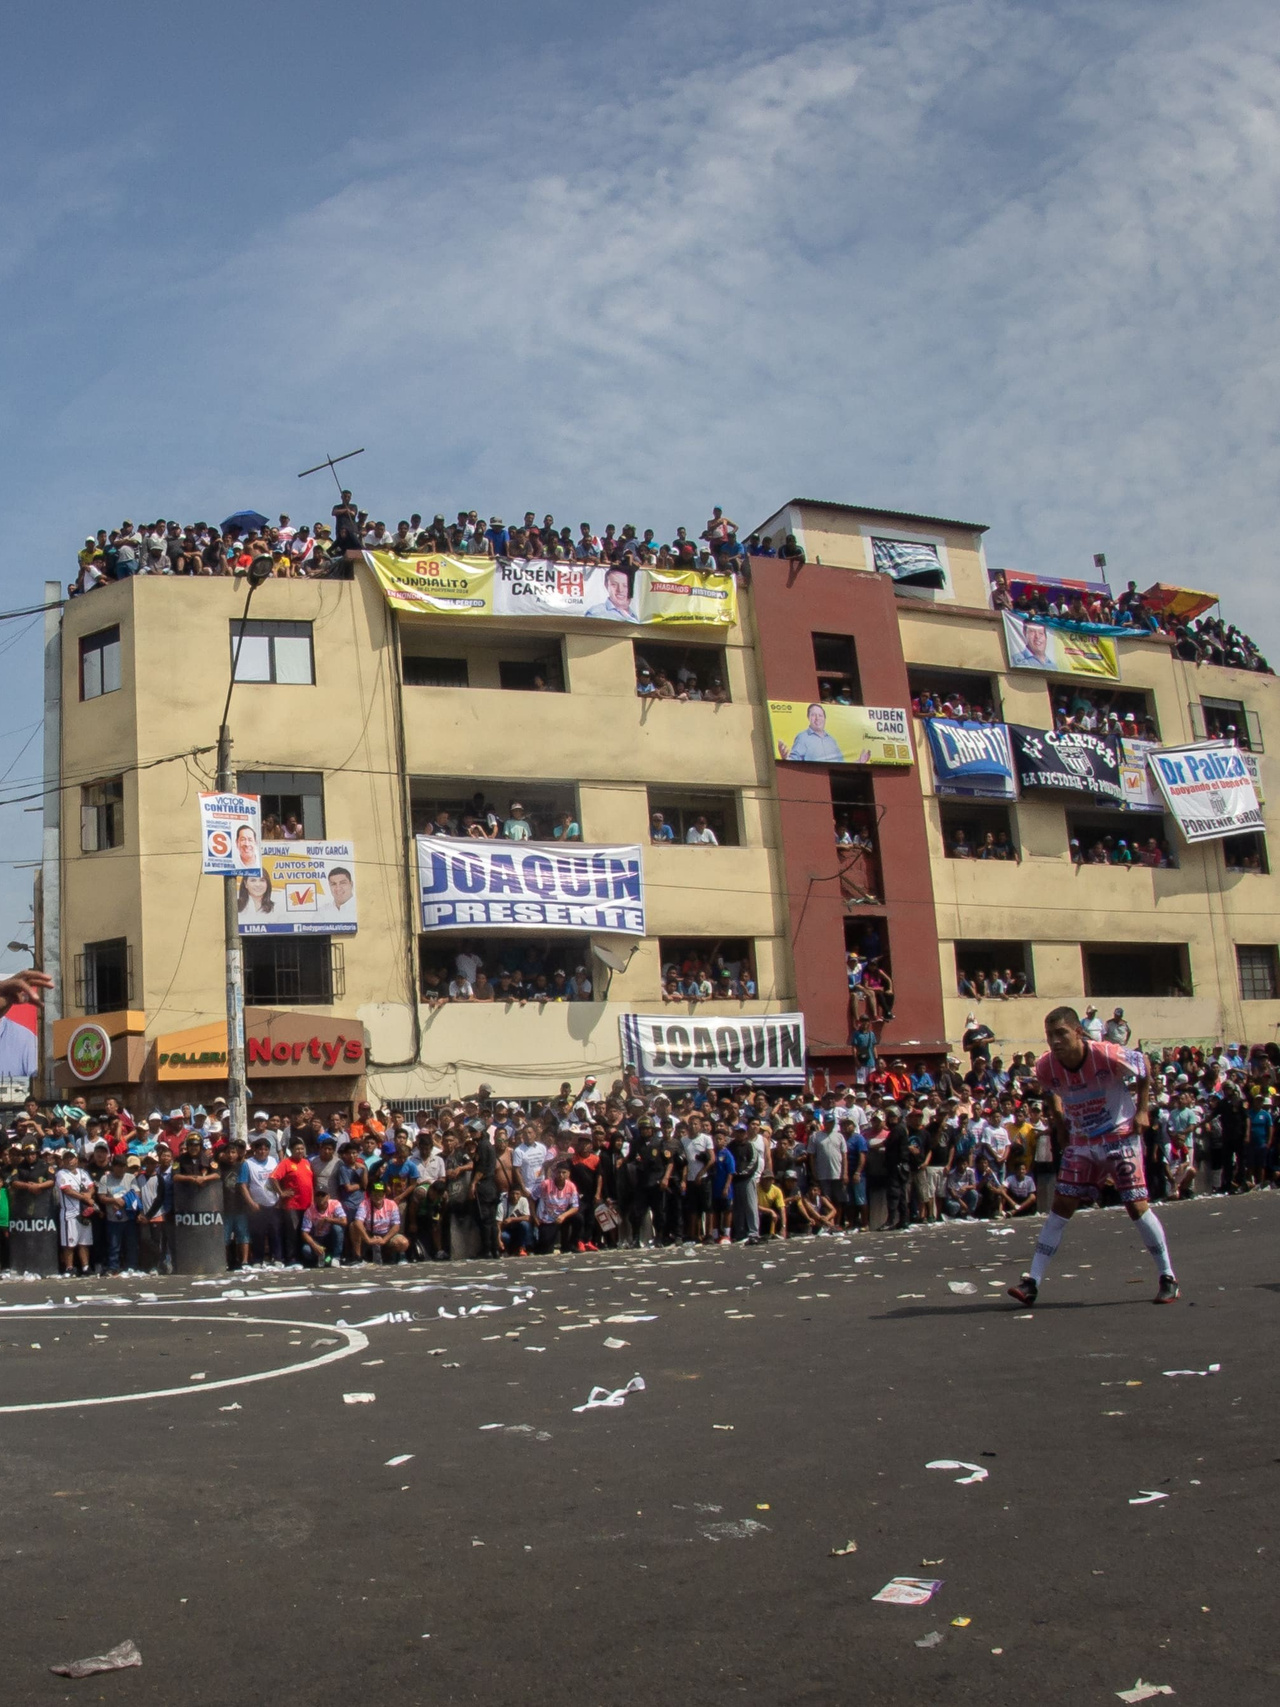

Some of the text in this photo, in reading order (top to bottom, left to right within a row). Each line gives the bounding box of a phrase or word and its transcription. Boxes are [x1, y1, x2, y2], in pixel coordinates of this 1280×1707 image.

[416, 561, 440, 577] 68
[502, 567, 555, 583] RUBÉN
[868, 707, 904, 721] RUBÉN
[877, 721, 904, 733] CANO
[1158, 753, 1246, 785] Dr Paliza
[1170, 783, 1211, 796] Apoyando
[215, 796, 244, 806] VICTOR
[204, 803, 256, 815] CONTRERAS
[1181, 816, 1236, 835] PORVENIR
[212, 833, 228, 855] S
[306, 844, 349, 855] RUDY GARCÍA
[275, 861, 325, 870] JUNTOS POR
[273, 871, 327, 880] LA VICTORIA
[423, 852, 642, 902] JOAQUÍN
[424, 902, 644, 930] PRESENTE
[244, 925, 267, 933] LIMA
[248, 1034, 363, 1067] Norty's
[651, 1024, 802, 1073] JOAQUIN
[159, 1051, 228, 1065] POLLERI
